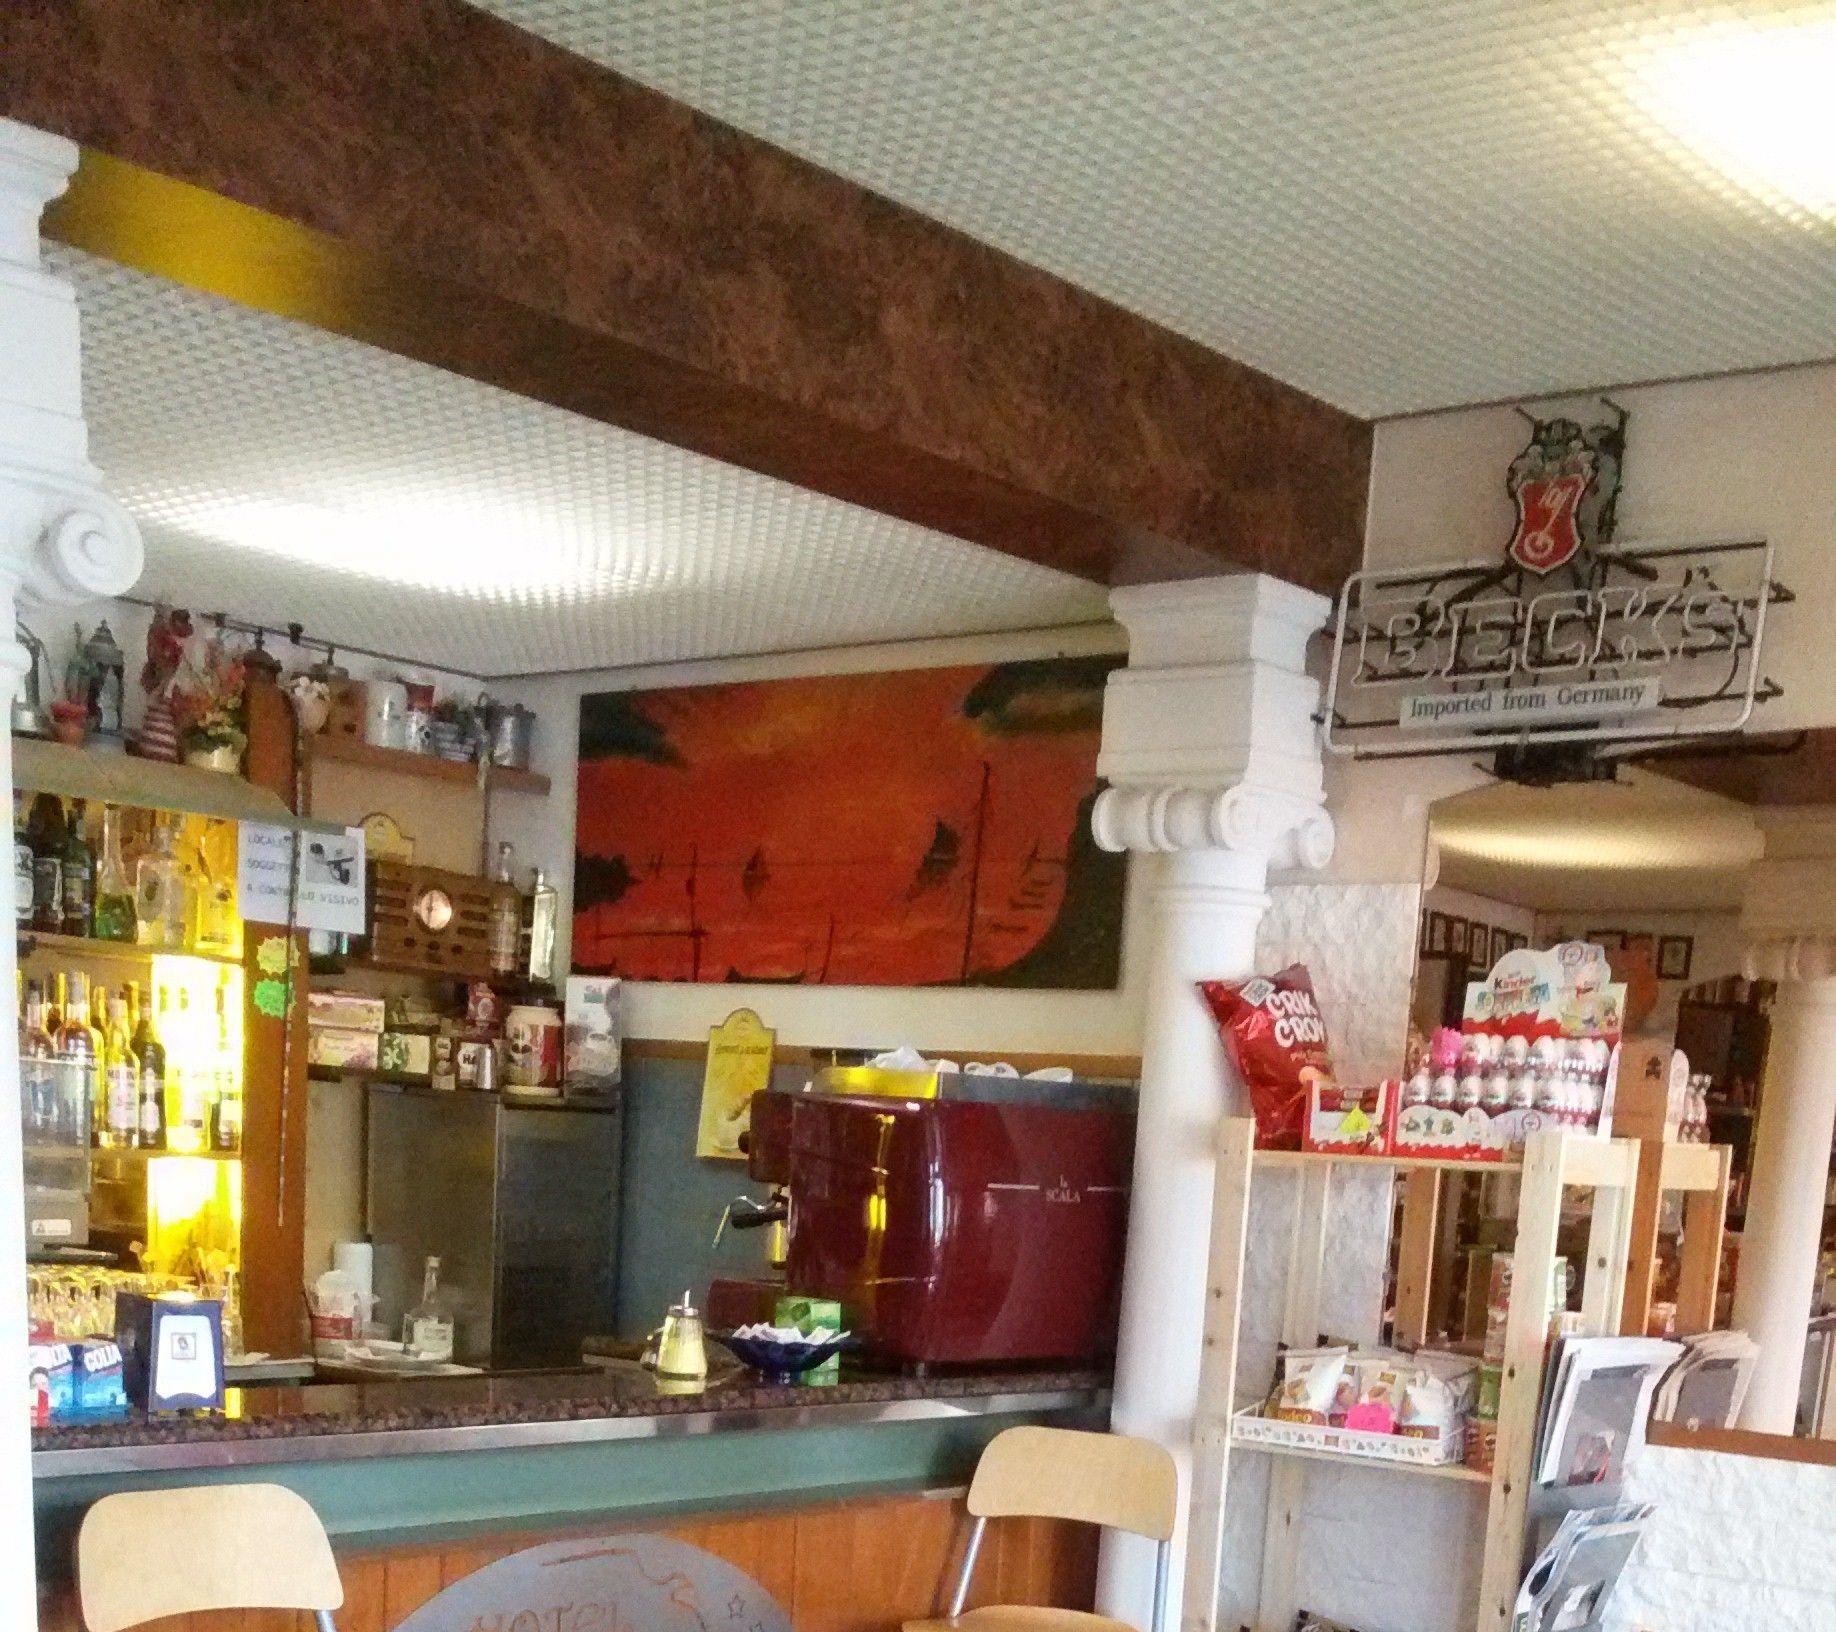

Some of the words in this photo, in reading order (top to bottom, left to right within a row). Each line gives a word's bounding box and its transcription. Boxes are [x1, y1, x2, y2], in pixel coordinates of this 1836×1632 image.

[1410, 690, 1492, 720] Imported
[1502, 690, 1546, 711] from
[1557, 683, 1646, 706] Germany
[1265, 989, 1319, 1019] CRIK
